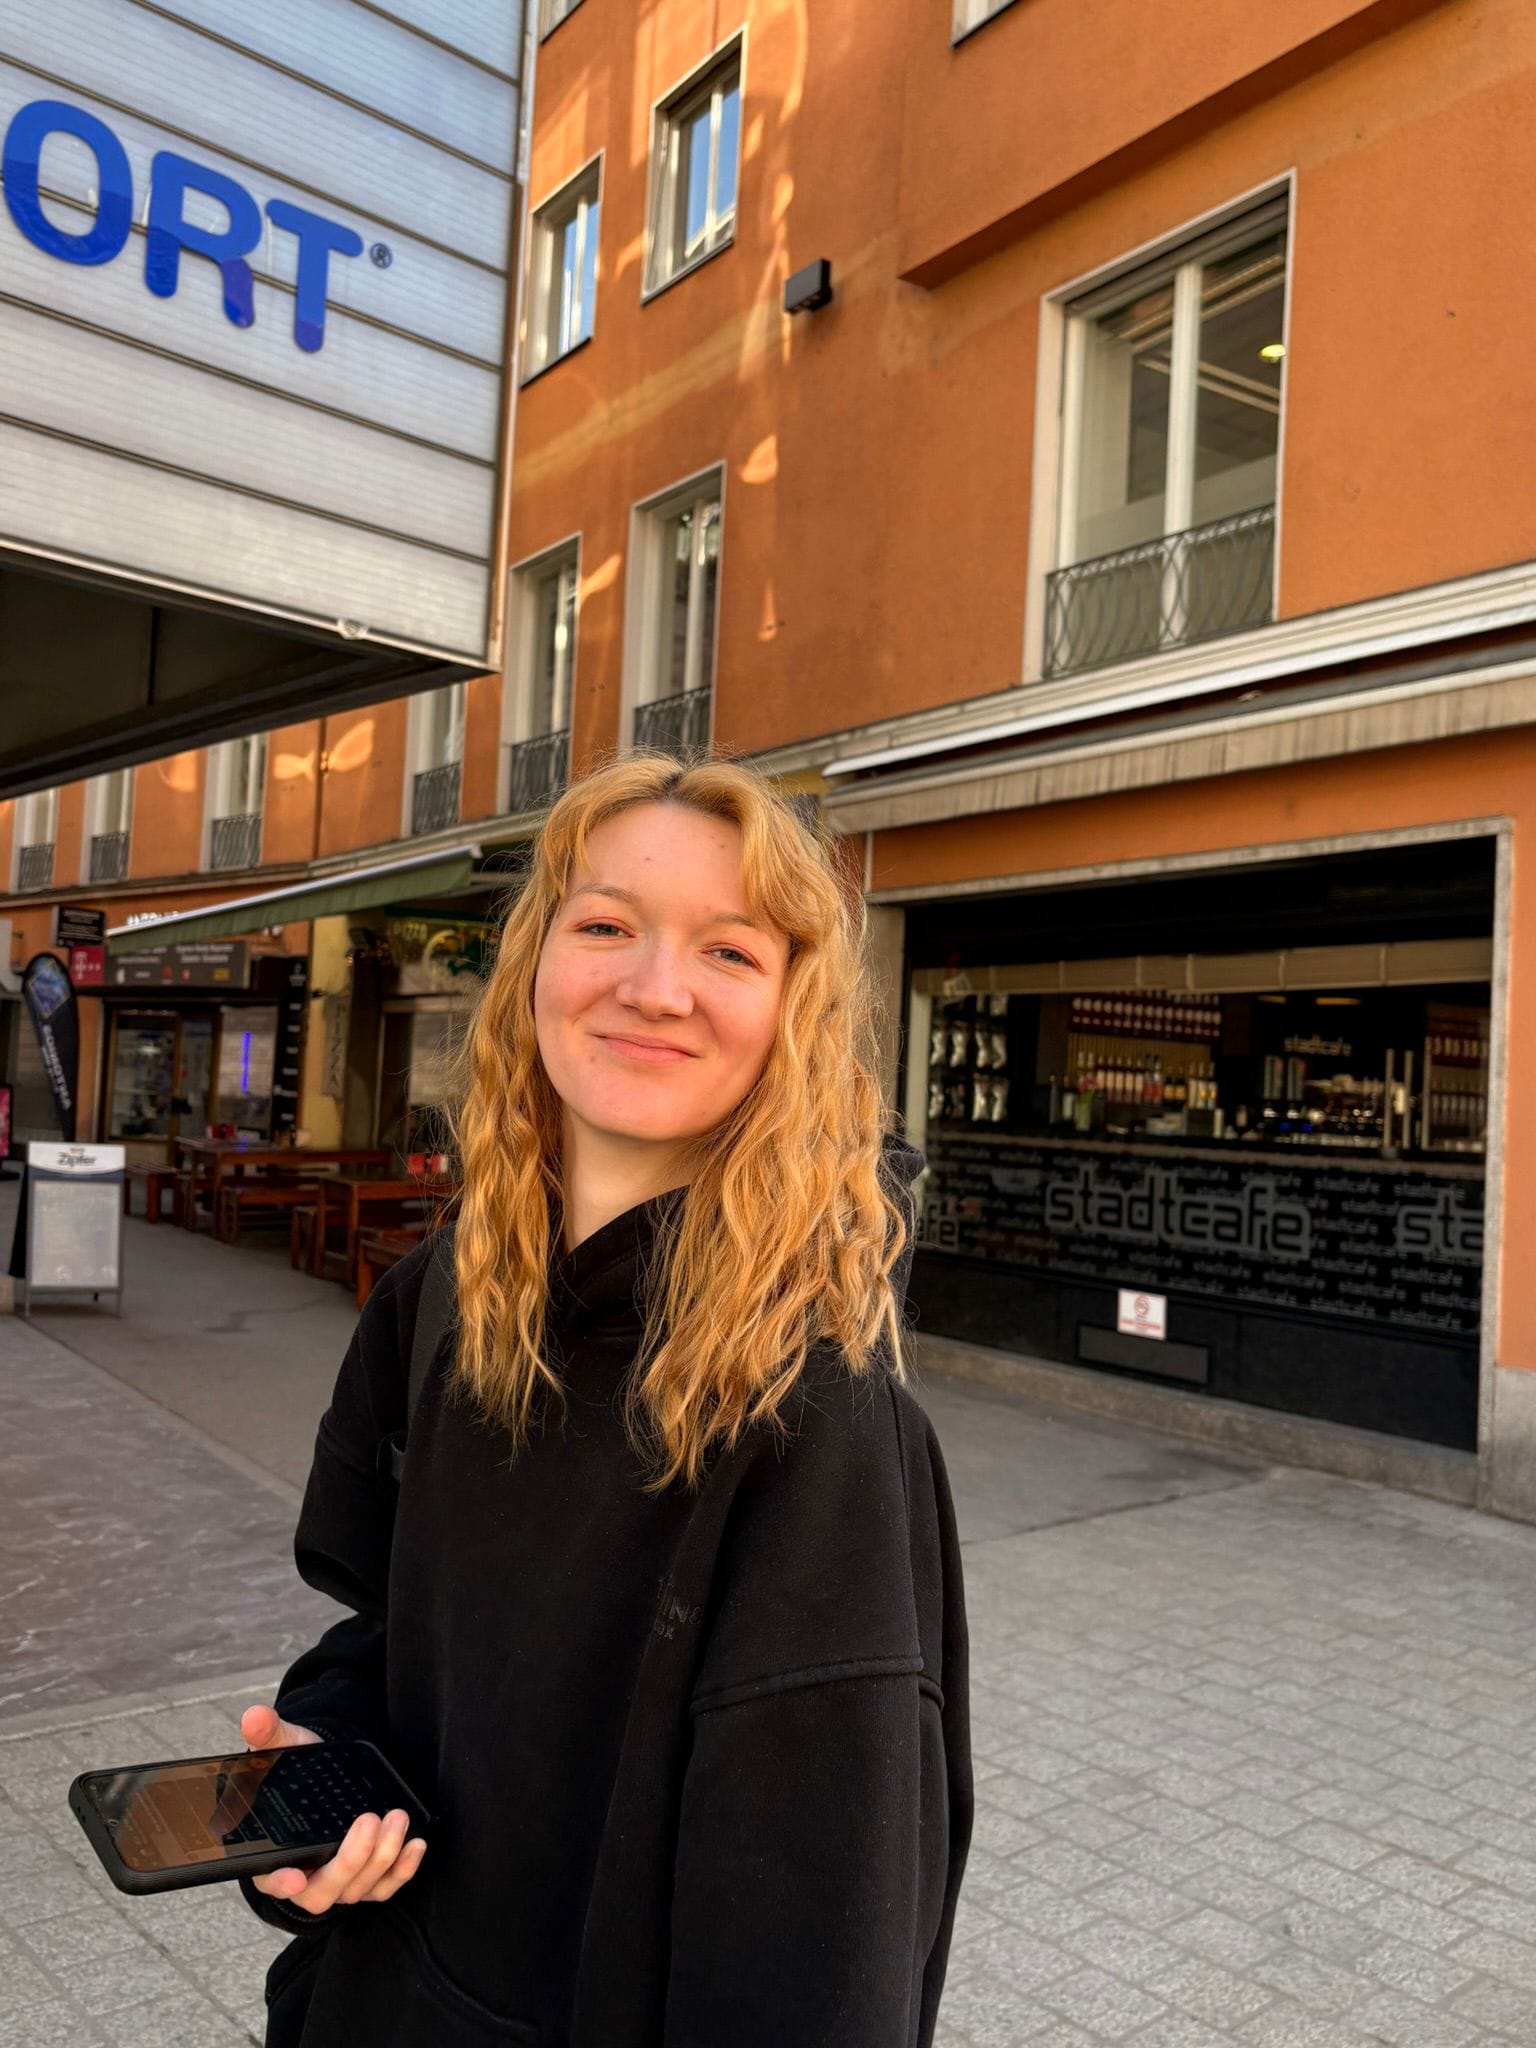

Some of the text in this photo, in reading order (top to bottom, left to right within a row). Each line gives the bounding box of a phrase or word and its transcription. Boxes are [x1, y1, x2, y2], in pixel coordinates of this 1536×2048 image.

[1284, 1034, 1352, 1057] stadtcafe
[1314, 1176, 1380, 1195] stadtcafe
[1049, 1168, 1306, 1253] stadtcafe
[1391, 1264, 1463, 1288] stadtcafe
